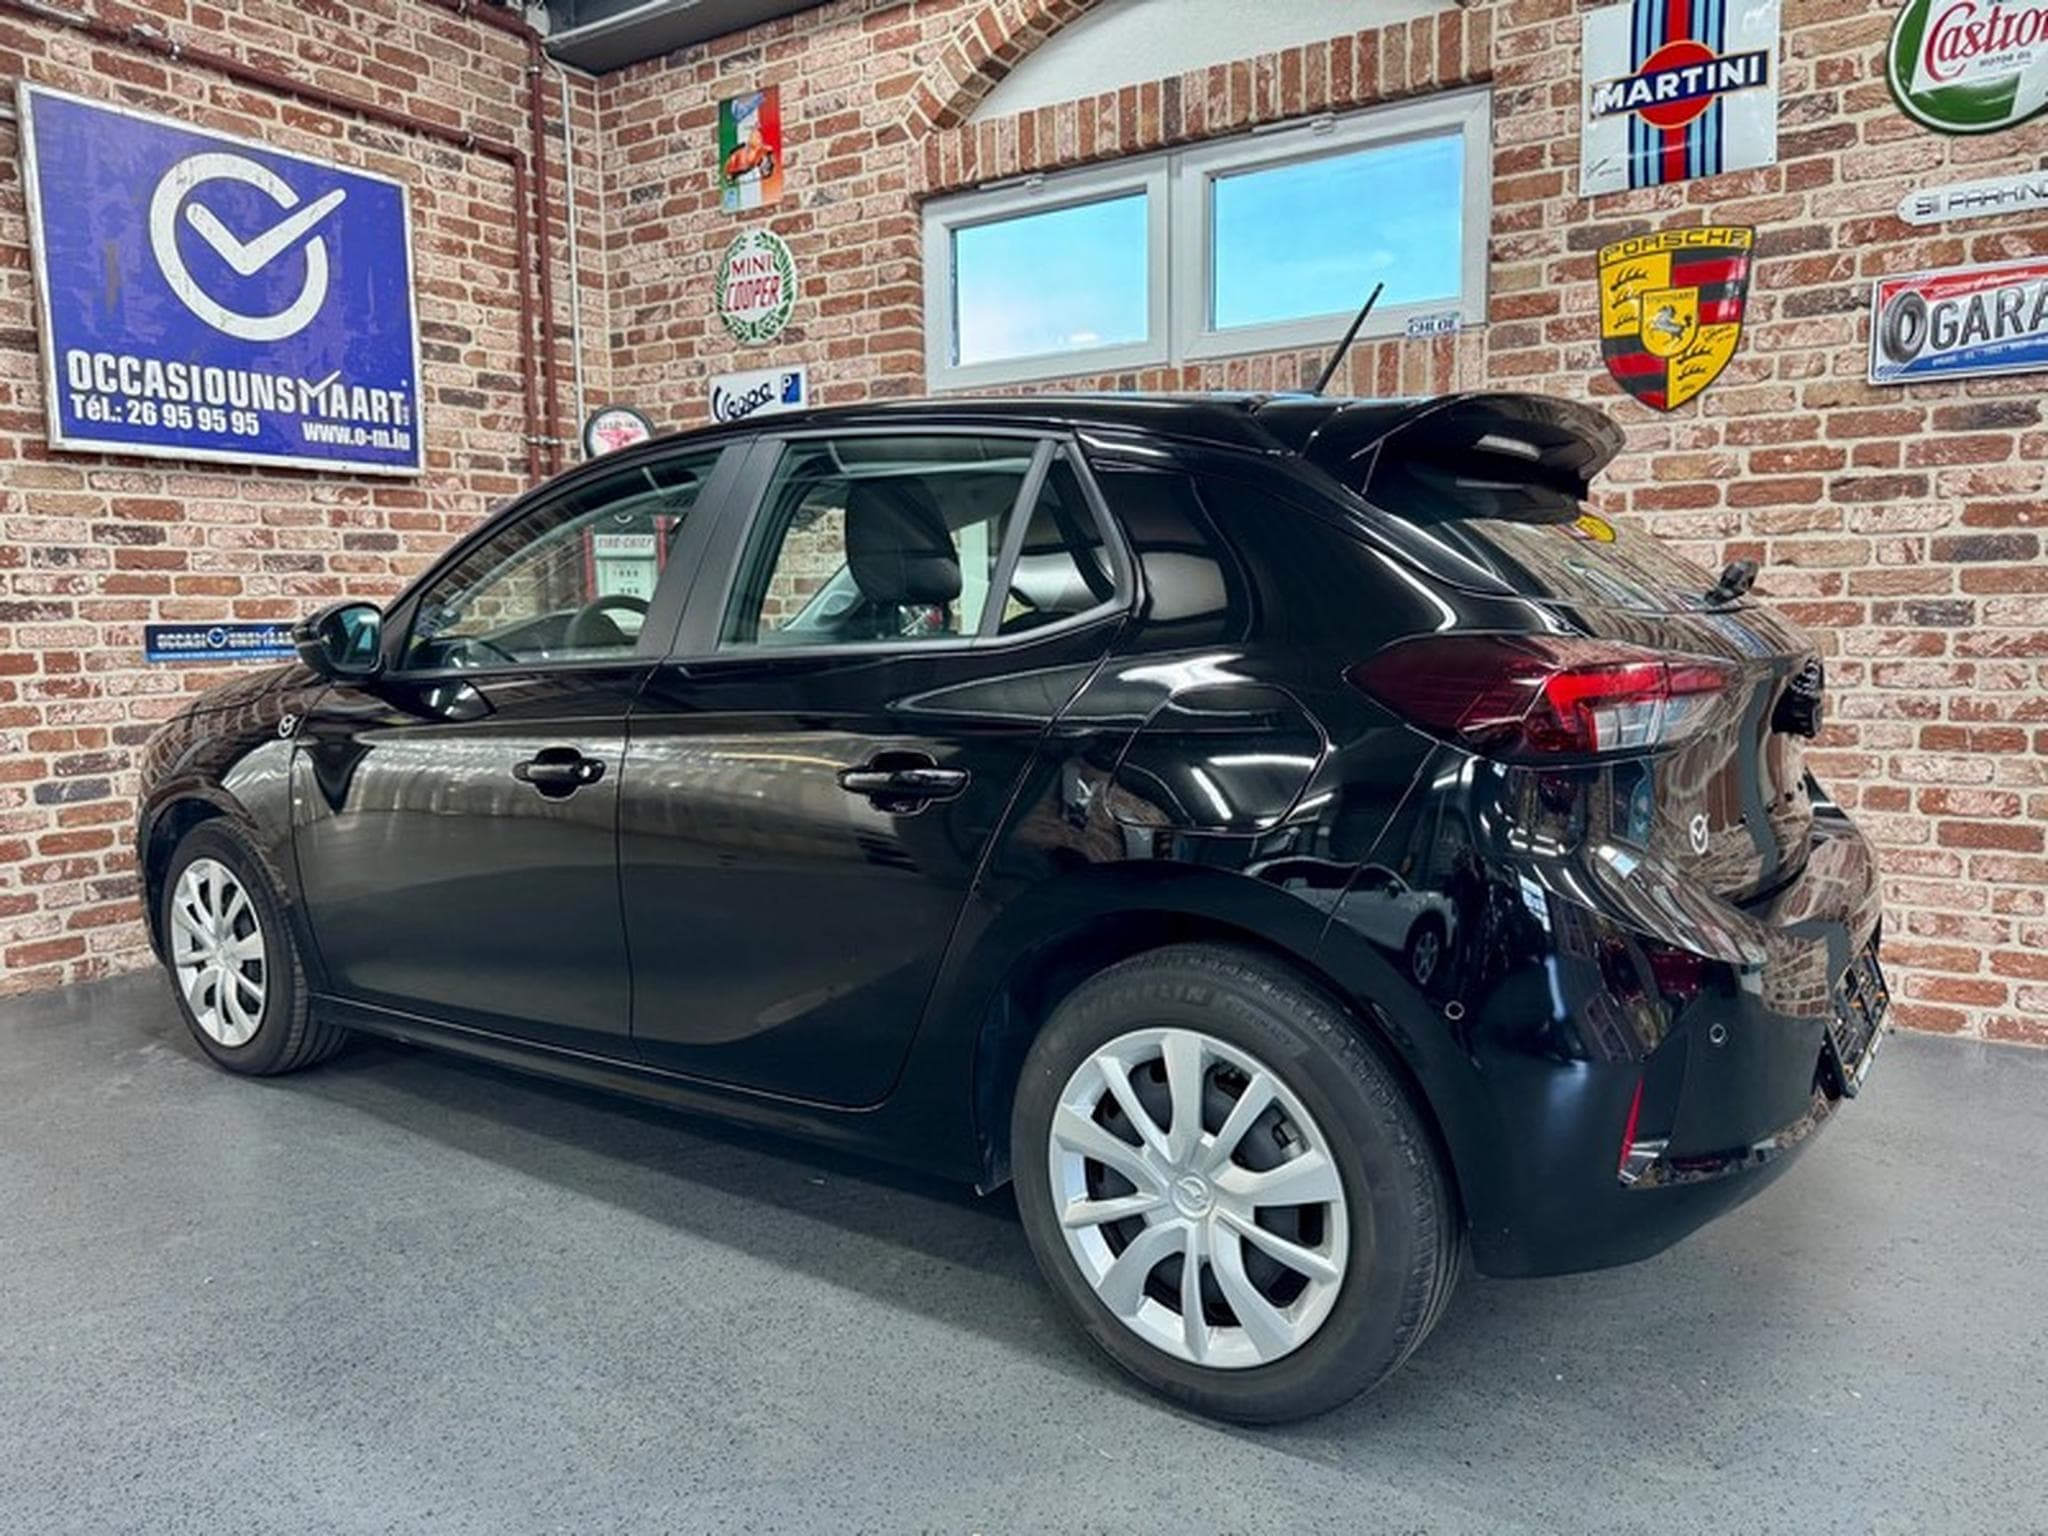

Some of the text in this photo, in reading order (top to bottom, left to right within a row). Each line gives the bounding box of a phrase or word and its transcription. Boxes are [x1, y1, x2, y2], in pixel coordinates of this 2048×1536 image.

[1592, 55, 1760, 113] MARTINI
[1603, 230, 1748, 261] PORSCHE
[732, 254, 771, 278] MINI
[726, 276, 780, 312] COOPER
[67, 349, 405, 425] OCCASIOUNSMAART
[713, 383, 775, 422] Vespa
[127, 399, 158, 426] 26
[162, 403, 193, 430] 95
[197, 406, 227, 433] 95
[230, 410, 260, 436] 95
[301, 421, 410, 450] www.o-m.lu
